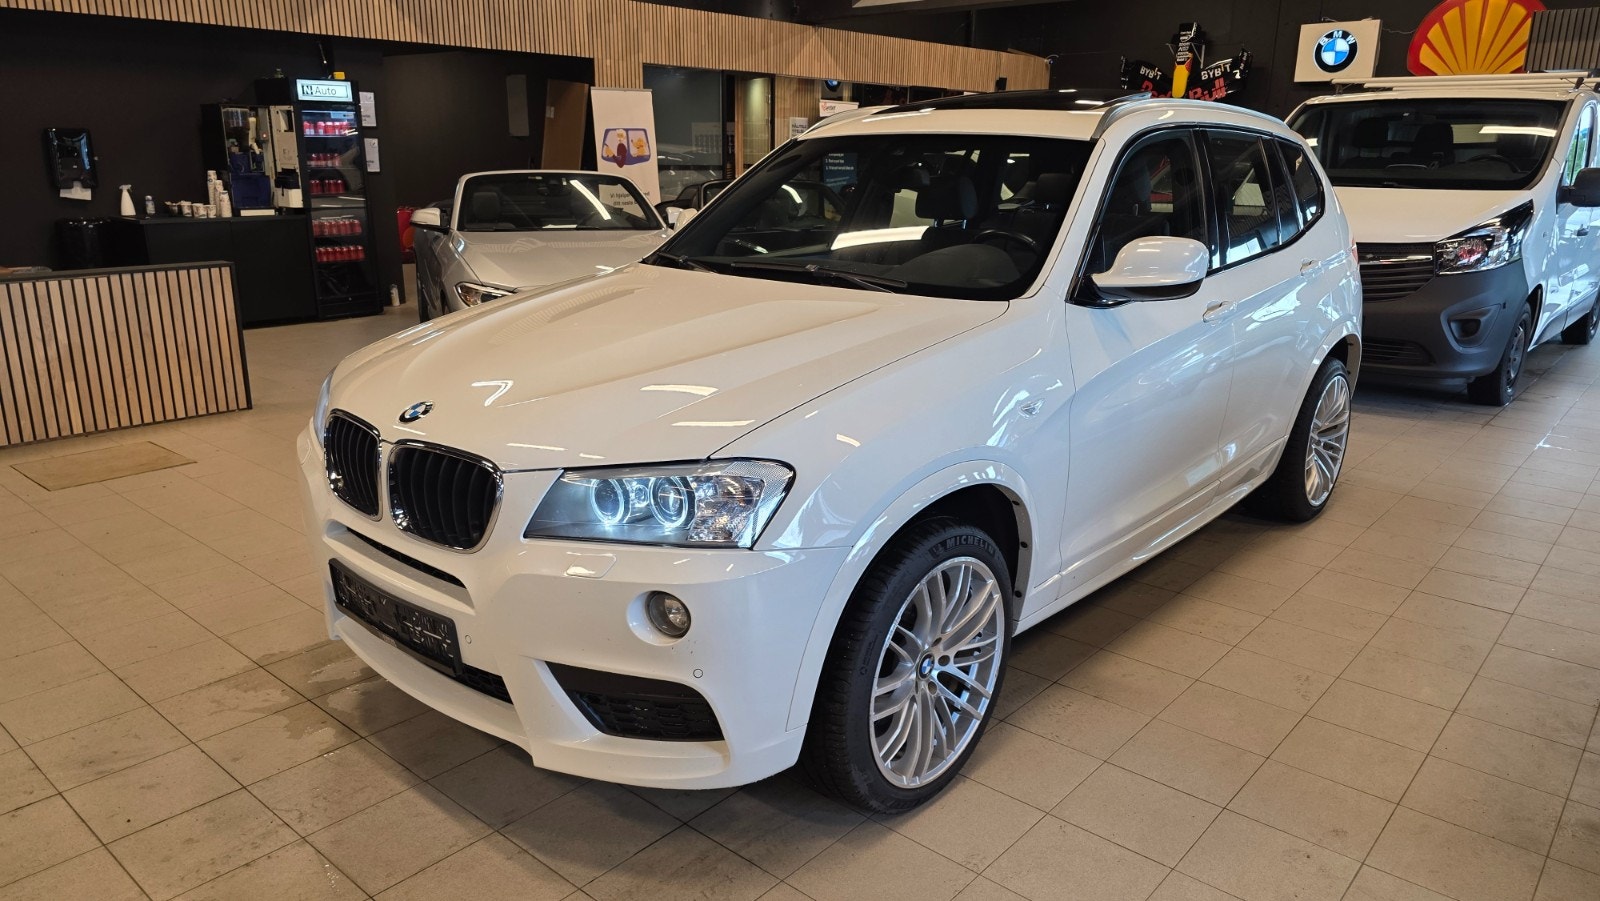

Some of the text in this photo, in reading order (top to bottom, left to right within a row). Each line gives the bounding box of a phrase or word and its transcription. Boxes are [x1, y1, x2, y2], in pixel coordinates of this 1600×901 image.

[1319, 30, 1356, 46] BMW
[1140, 65, 1162, 80] BYBIT
[1201, 63, 1231, 80] BYBIT
[315, 86, 337, 95] Auto
[946, 535, 995, 555] MICHELIN
